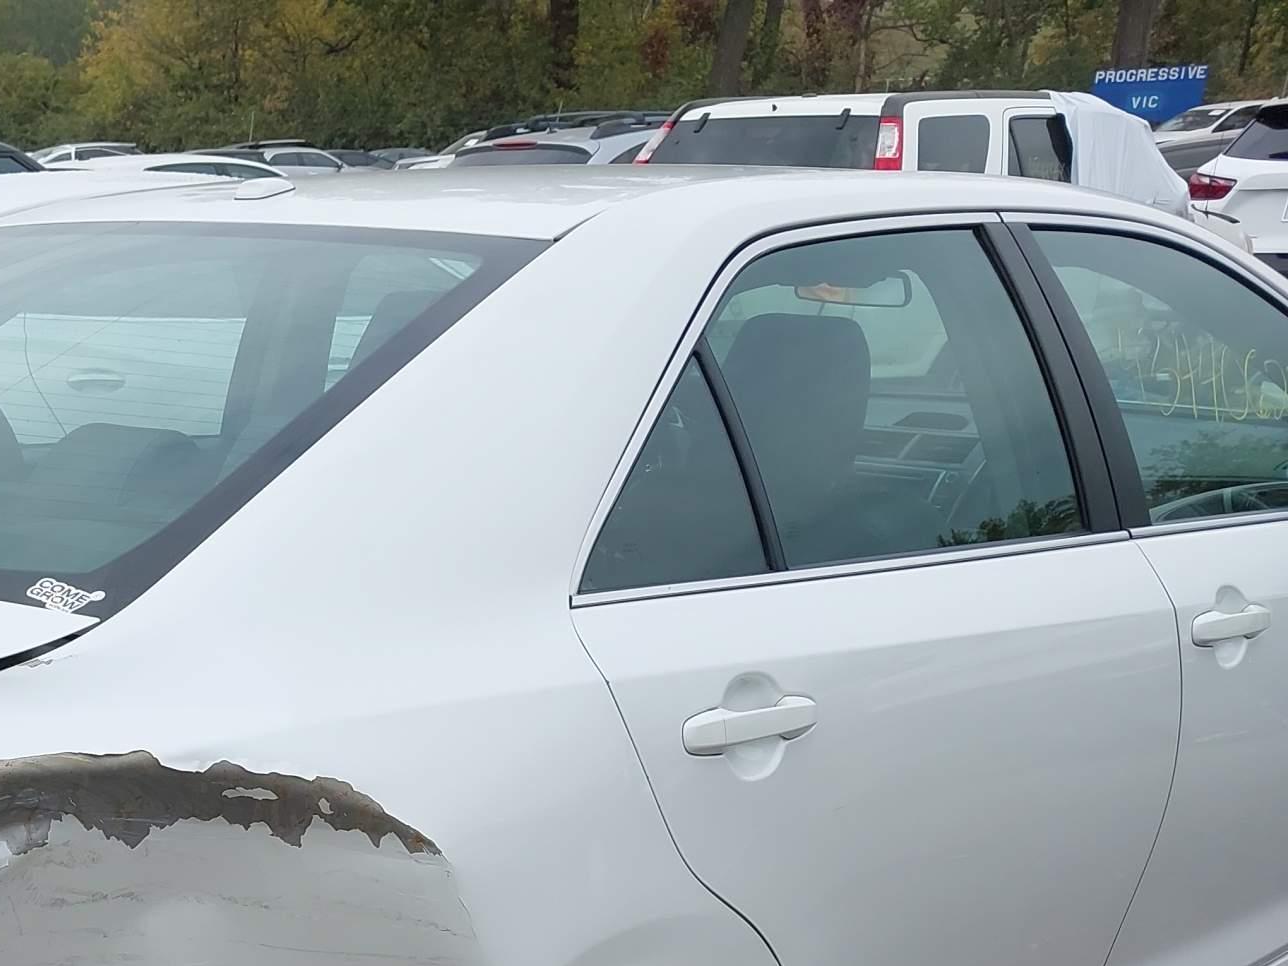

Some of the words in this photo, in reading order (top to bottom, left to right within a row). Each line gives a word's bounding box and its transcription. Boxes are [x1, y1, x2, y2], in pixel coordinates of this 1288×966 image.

[1094, 64, 1208, 84] PROGRESSIVE
[1131, 95, 1159, 109] VIC
[30, 587, 80, 610] GROW
[39, 580, 91, 604] COME
